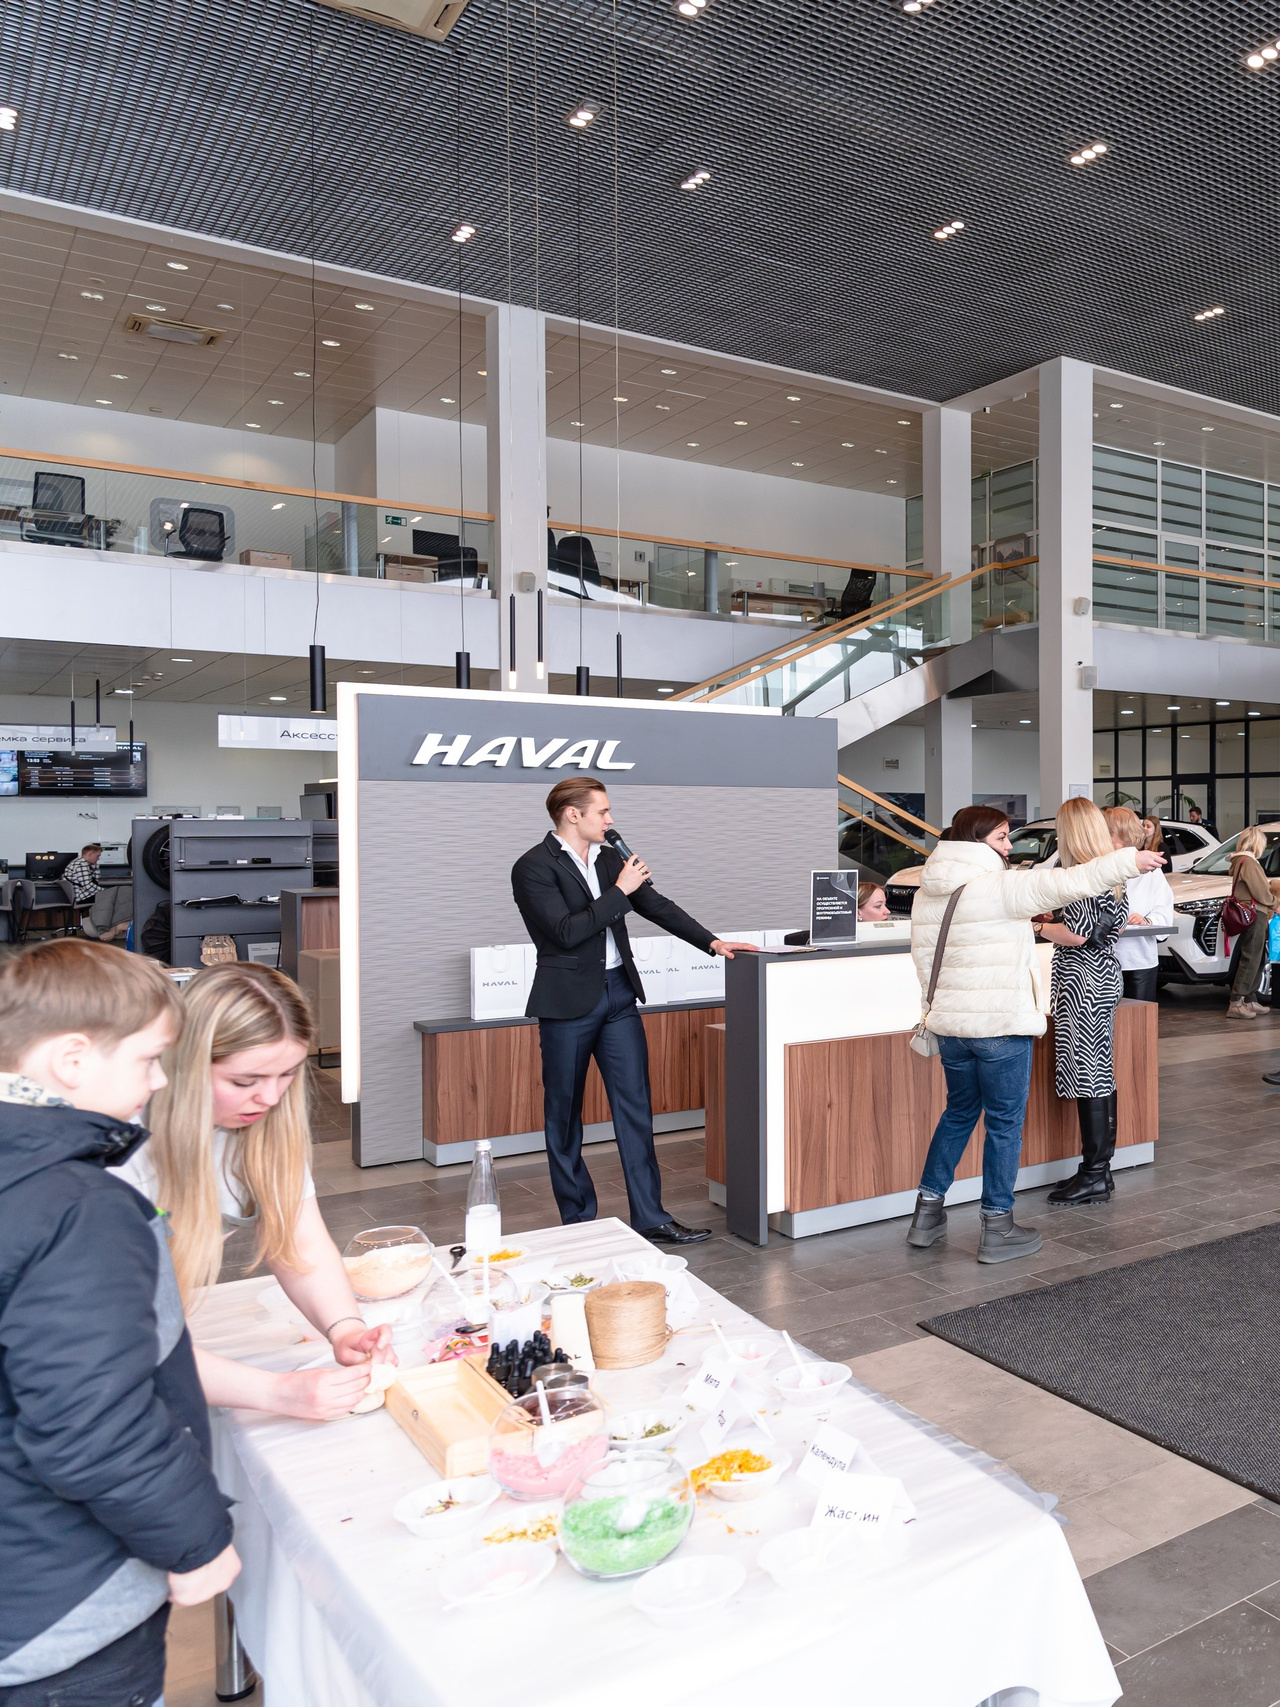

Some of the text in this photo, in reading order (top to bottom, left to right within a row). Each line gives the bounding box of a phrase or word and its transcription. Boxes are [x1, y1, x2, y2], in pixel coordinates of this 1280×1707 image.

[411, 733, 636, 770] HAVAL
[482, 980, 518, 988] HAVAL
[704, 1373, 720, 1389] Мята
[810, 1443, 846, 1472] Календула
[825, 1505, 880, 1523] Жасин
